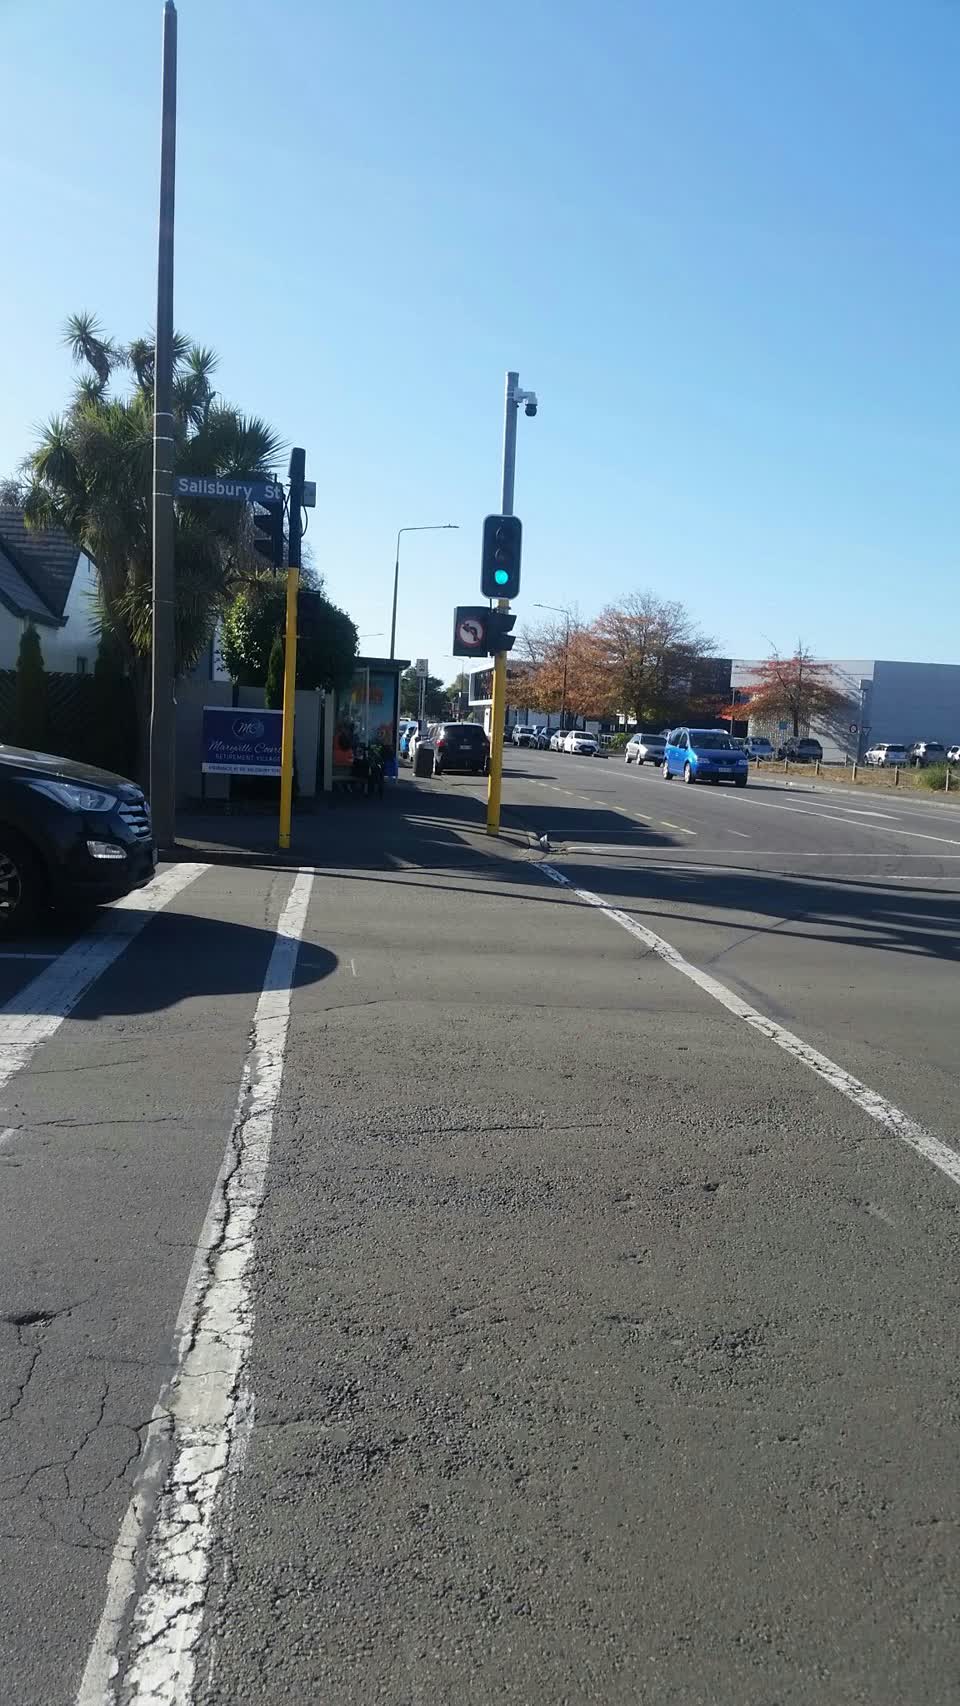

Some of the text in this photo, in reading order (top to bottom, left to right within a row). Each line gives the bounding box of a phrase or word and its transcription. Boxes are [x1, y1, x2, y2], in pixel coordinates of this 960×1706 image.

[179, 478, 281, 500] Salisbury St
[215, 753, 254, 761] RETIREMENT
